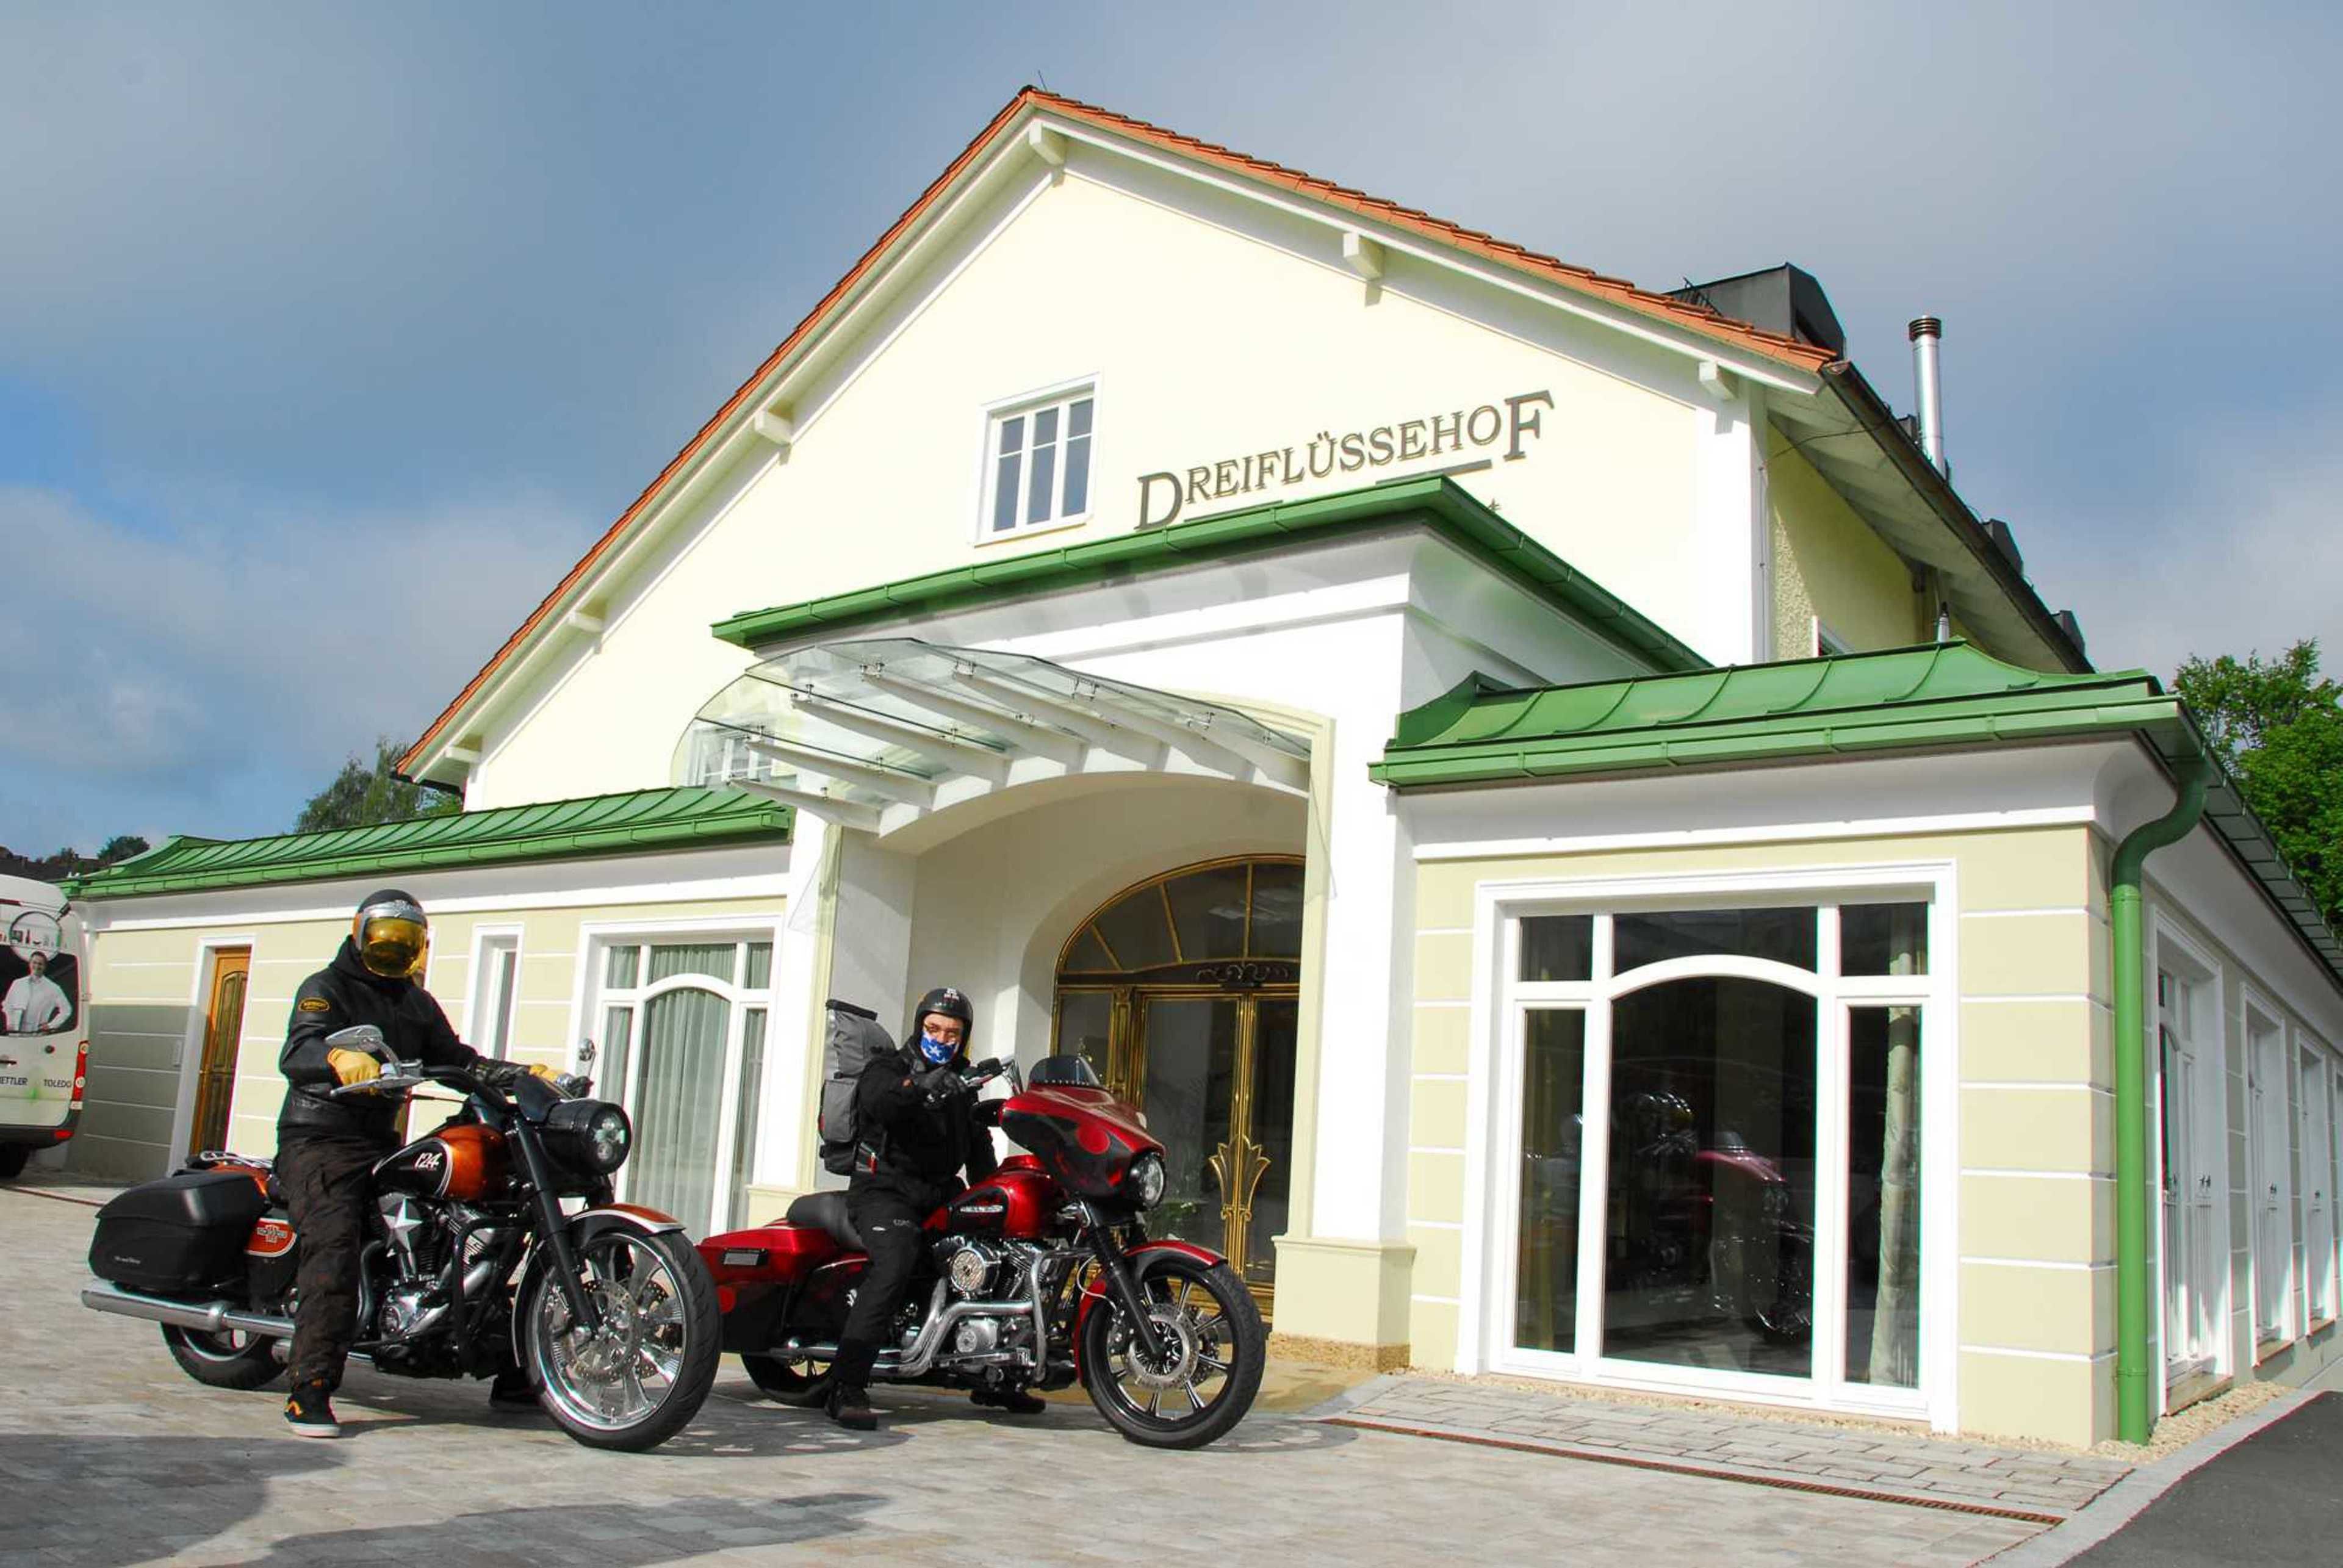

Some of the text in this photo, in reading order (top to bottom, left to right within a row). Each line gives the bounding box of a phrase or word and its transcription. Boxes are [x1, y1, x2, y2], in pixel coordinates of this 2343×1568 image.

[1133, 390, 1555, 531] DREIFLÜSSEHOF
[0, 1076, 72, 1088] ETTLER TOLEDO
[414, 1153, 442, 1169] 124
